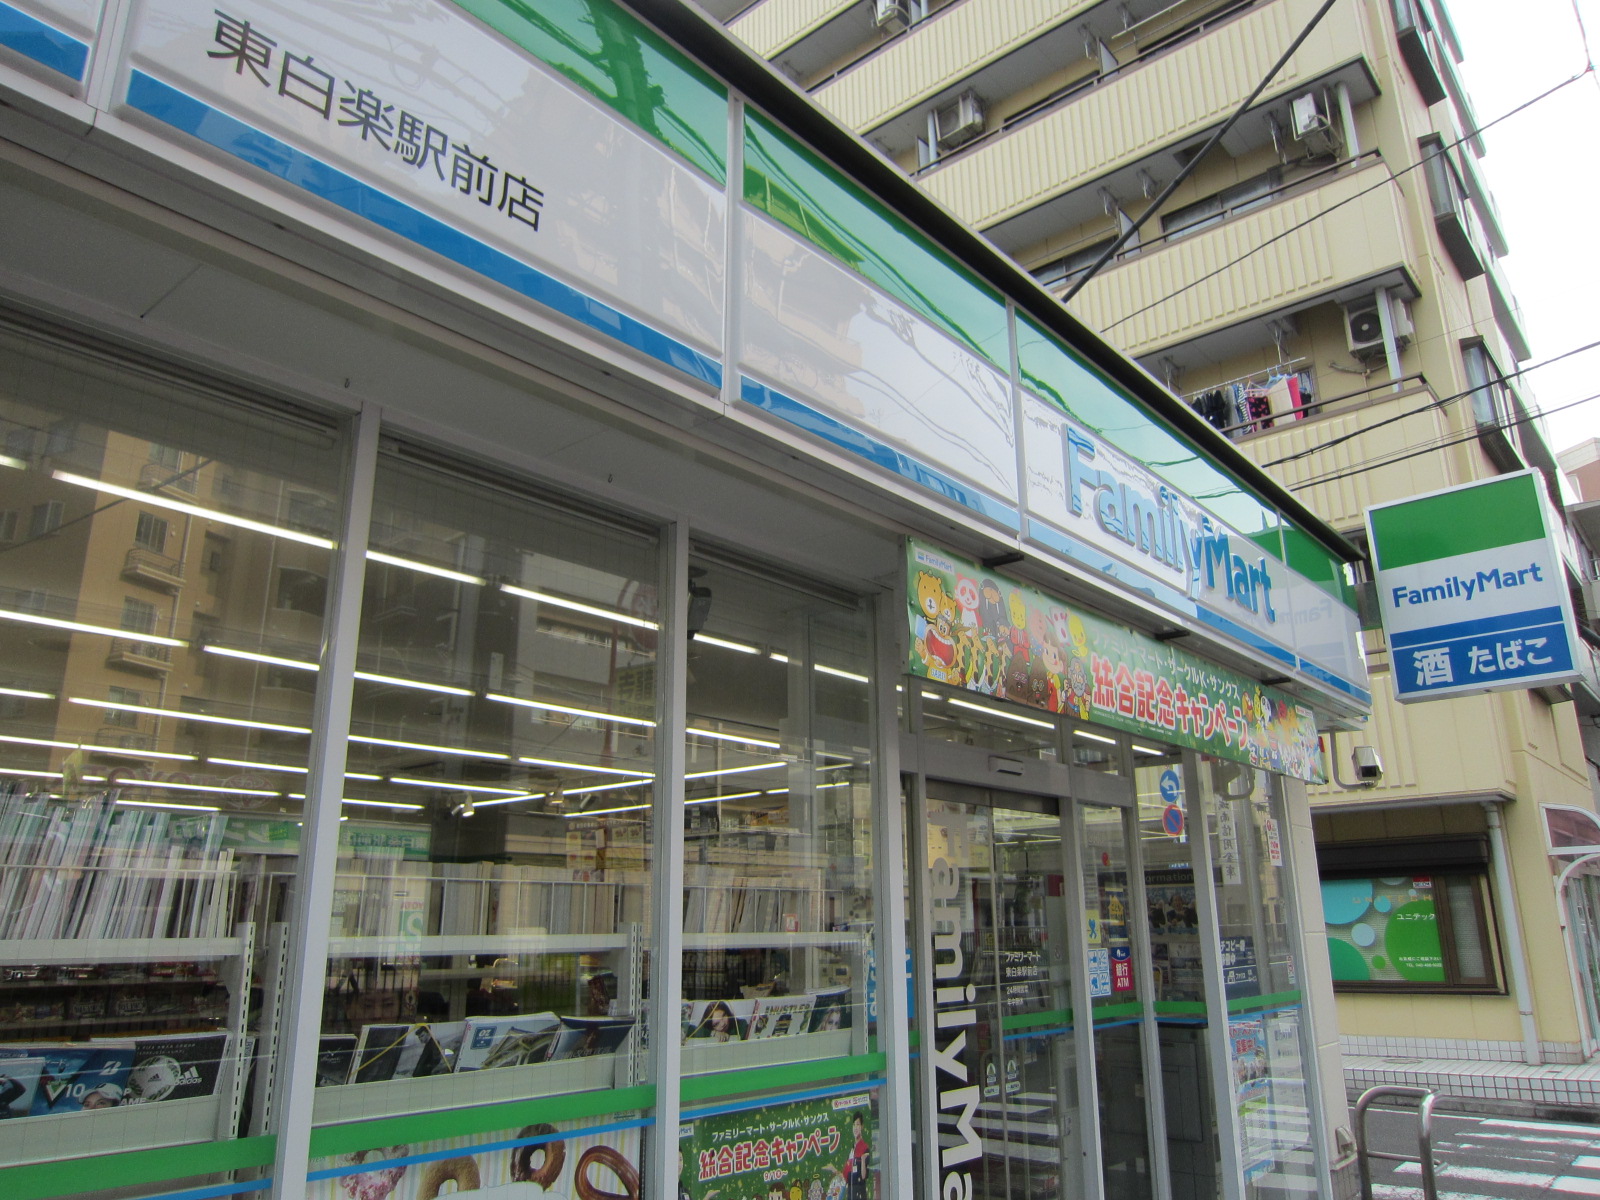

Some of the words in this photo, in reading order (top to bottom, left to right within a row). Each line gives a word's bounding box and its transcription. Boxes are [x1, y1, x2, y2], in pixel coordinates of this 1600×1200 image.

[206, 8, 545, 232] 東白楽駅前店
[1061, 422, 1276, 624] FamilyMart
[925, 554, 953, 573] FamilyMart
[1392, 562, 1543, 608] FamilyMart
[1412, 646, 1453, 686] 酒
[1468, 636, 1553, 675] たばこ
[1090, 651, 1249, 751] 統合記念キャンペーン
[1396, 912, 1436, 921] ユニテック
[1004, 950, 1041, 963] ファミリーマート
[1116, 977, 1130, 988] ATM
[711, 1111, 830, 1143] ファミリーマート・サークルK・サンクス
[698, 1125, 841, 1182] 統合記念キャンペーン
